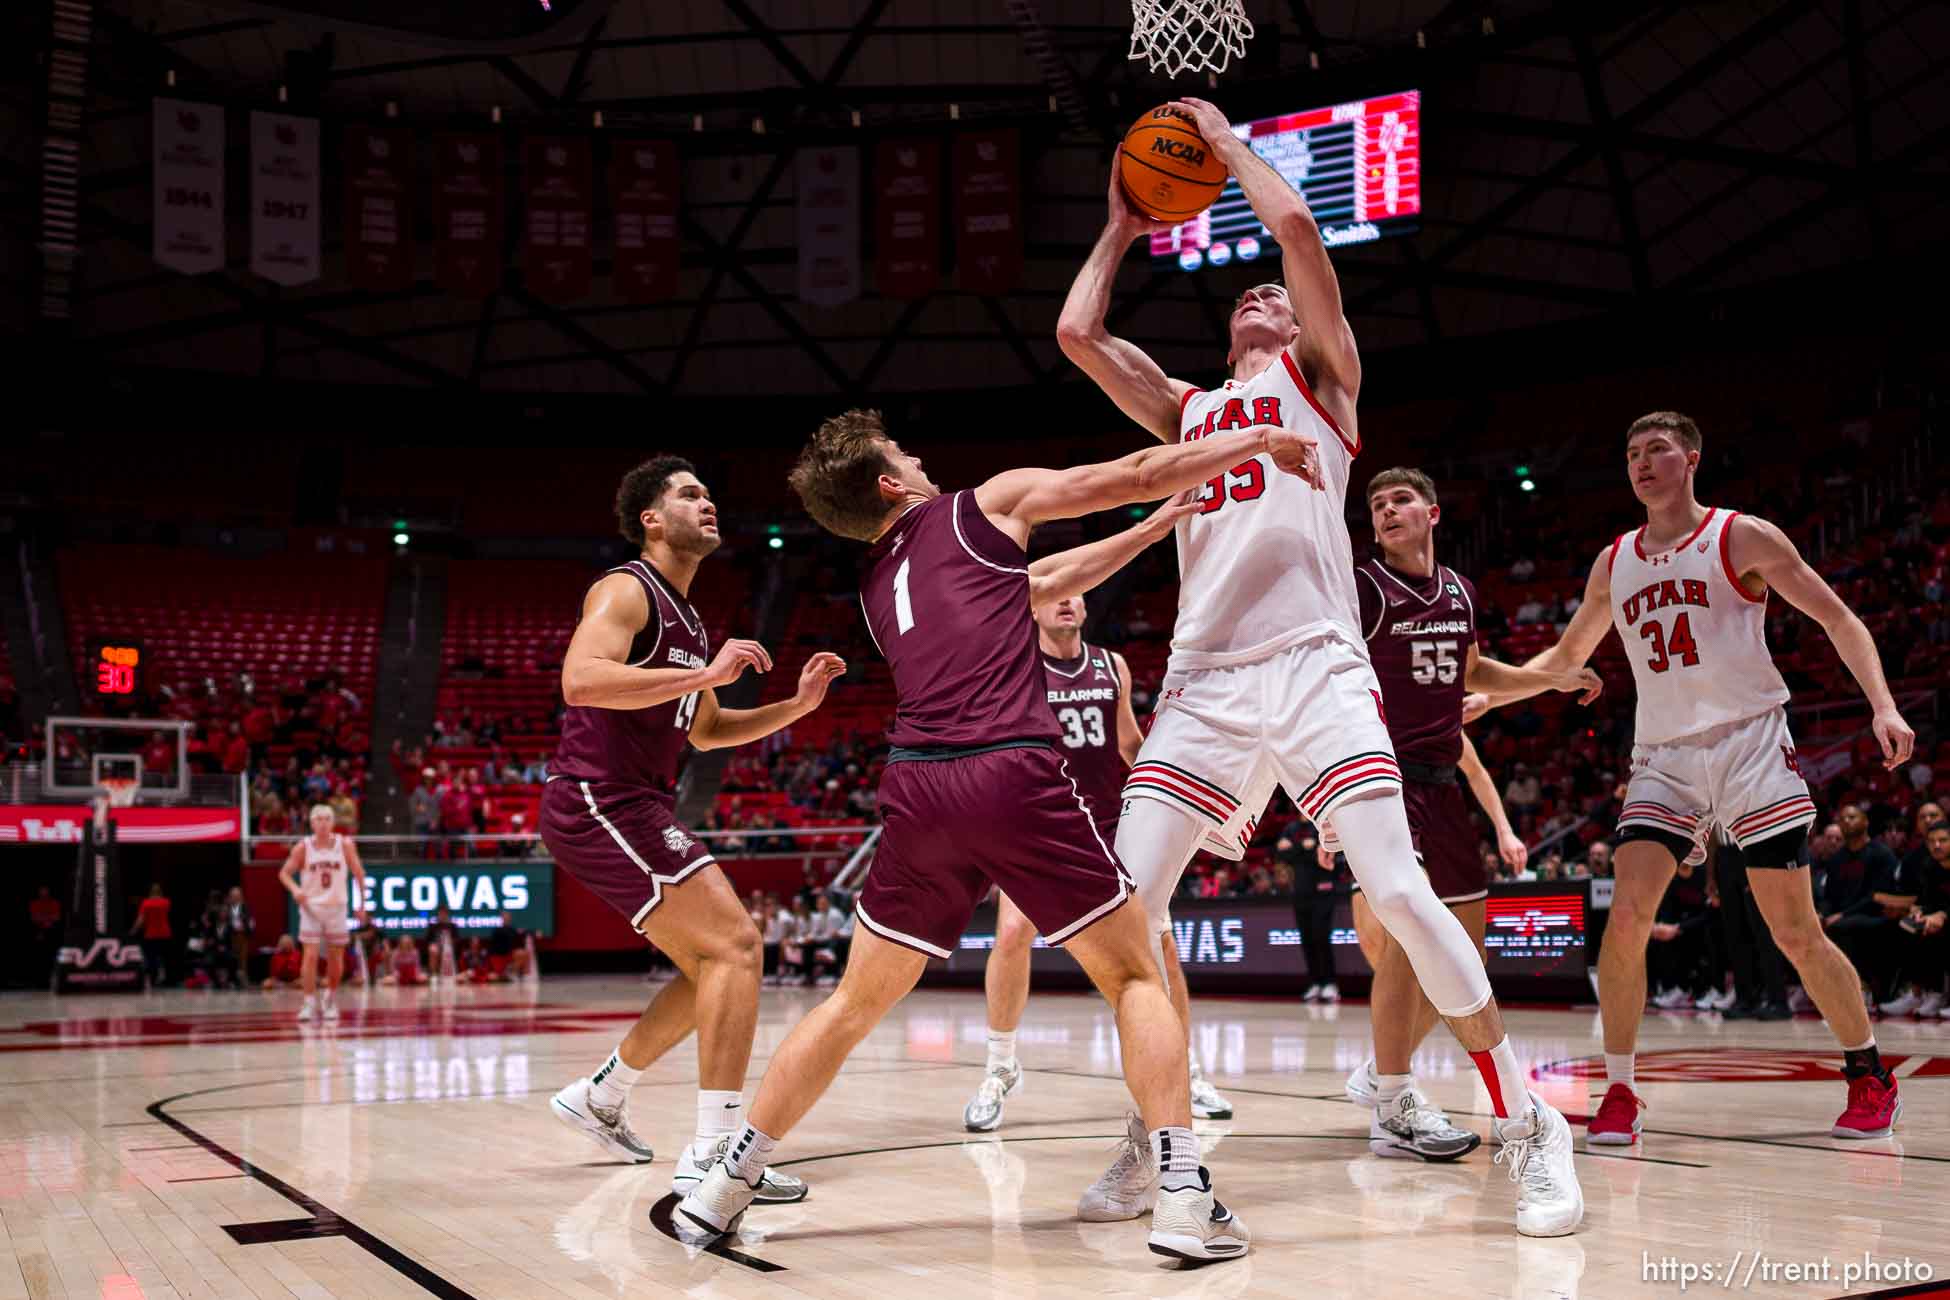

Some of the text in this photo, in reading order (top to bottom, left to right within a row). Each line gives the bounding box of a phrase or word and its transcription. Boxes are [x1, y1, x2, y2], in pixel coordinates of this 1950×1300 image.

[1151, 137, 1206, 168] NCAA
[893, 556, 915, 634] 1
[1622, 579, 1710, 626] UTAH
[1390, 620, 1468, 635] BELLARMINE
[1640, 612, 1700, 673] 34
[667, 647, 706, 672] BELLAR
[1411, 640, 1458, 684] 55
[98, 664, 134, 694] 30
[1048, 688, 1113, 703] ELLARMINE
[1058, 706, 1106, 749] 33
[351, 875, 529, 911] ECOVAS
